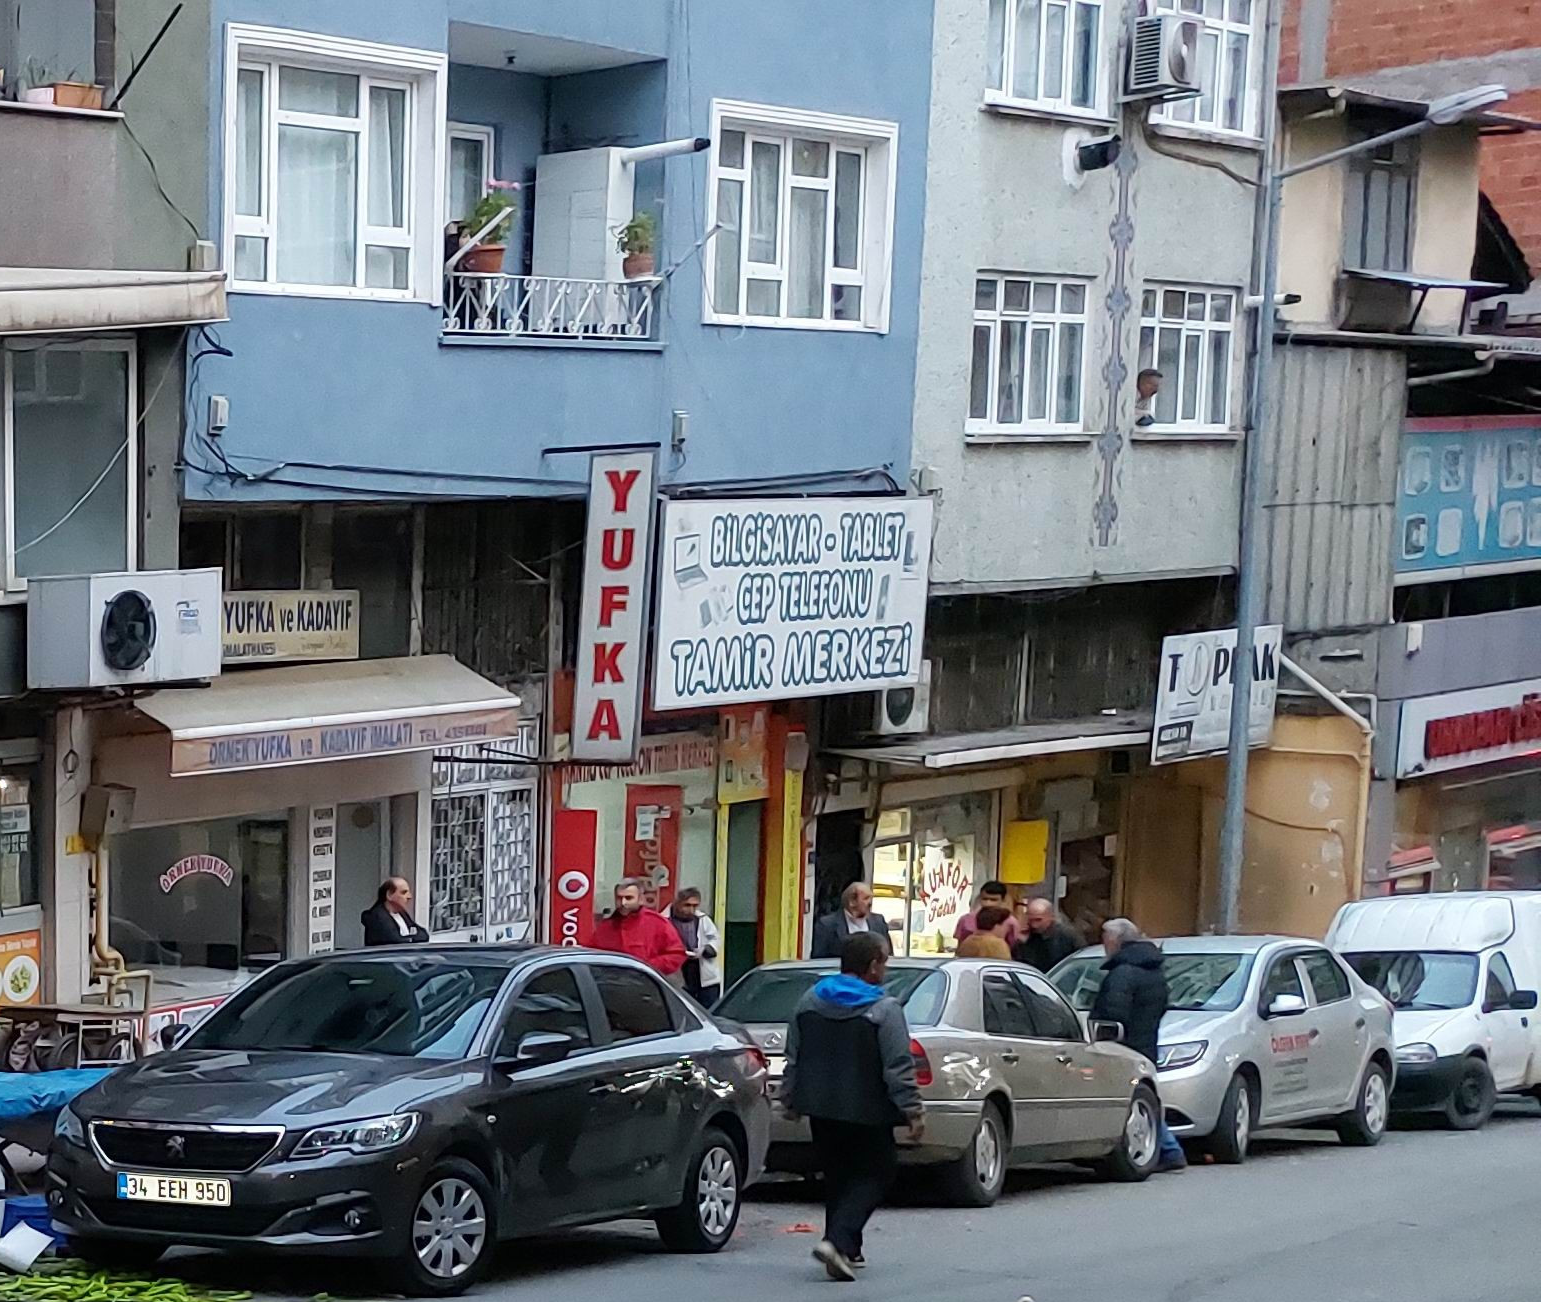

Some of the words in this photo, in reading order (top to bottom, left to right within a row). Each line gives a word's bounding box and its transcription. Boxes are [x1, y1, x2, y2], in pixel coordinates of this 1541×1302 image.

[840, 511, 905, 562] TABLET
[224, 600, 275, 634] YUFKA
[280, 608, 294, 632] ve
[297, 599, 353, 632] KADAYIF
[586, 470, 641, 741] YUFKA
[737, 573, 775, 625] CEP
[778, 569, 874, 621] TELEFONU
[128, 1178, 148, 1196] 34
[158, 1179, 188, 1199] EEH
[195, 1181, 226, 1202] 950
